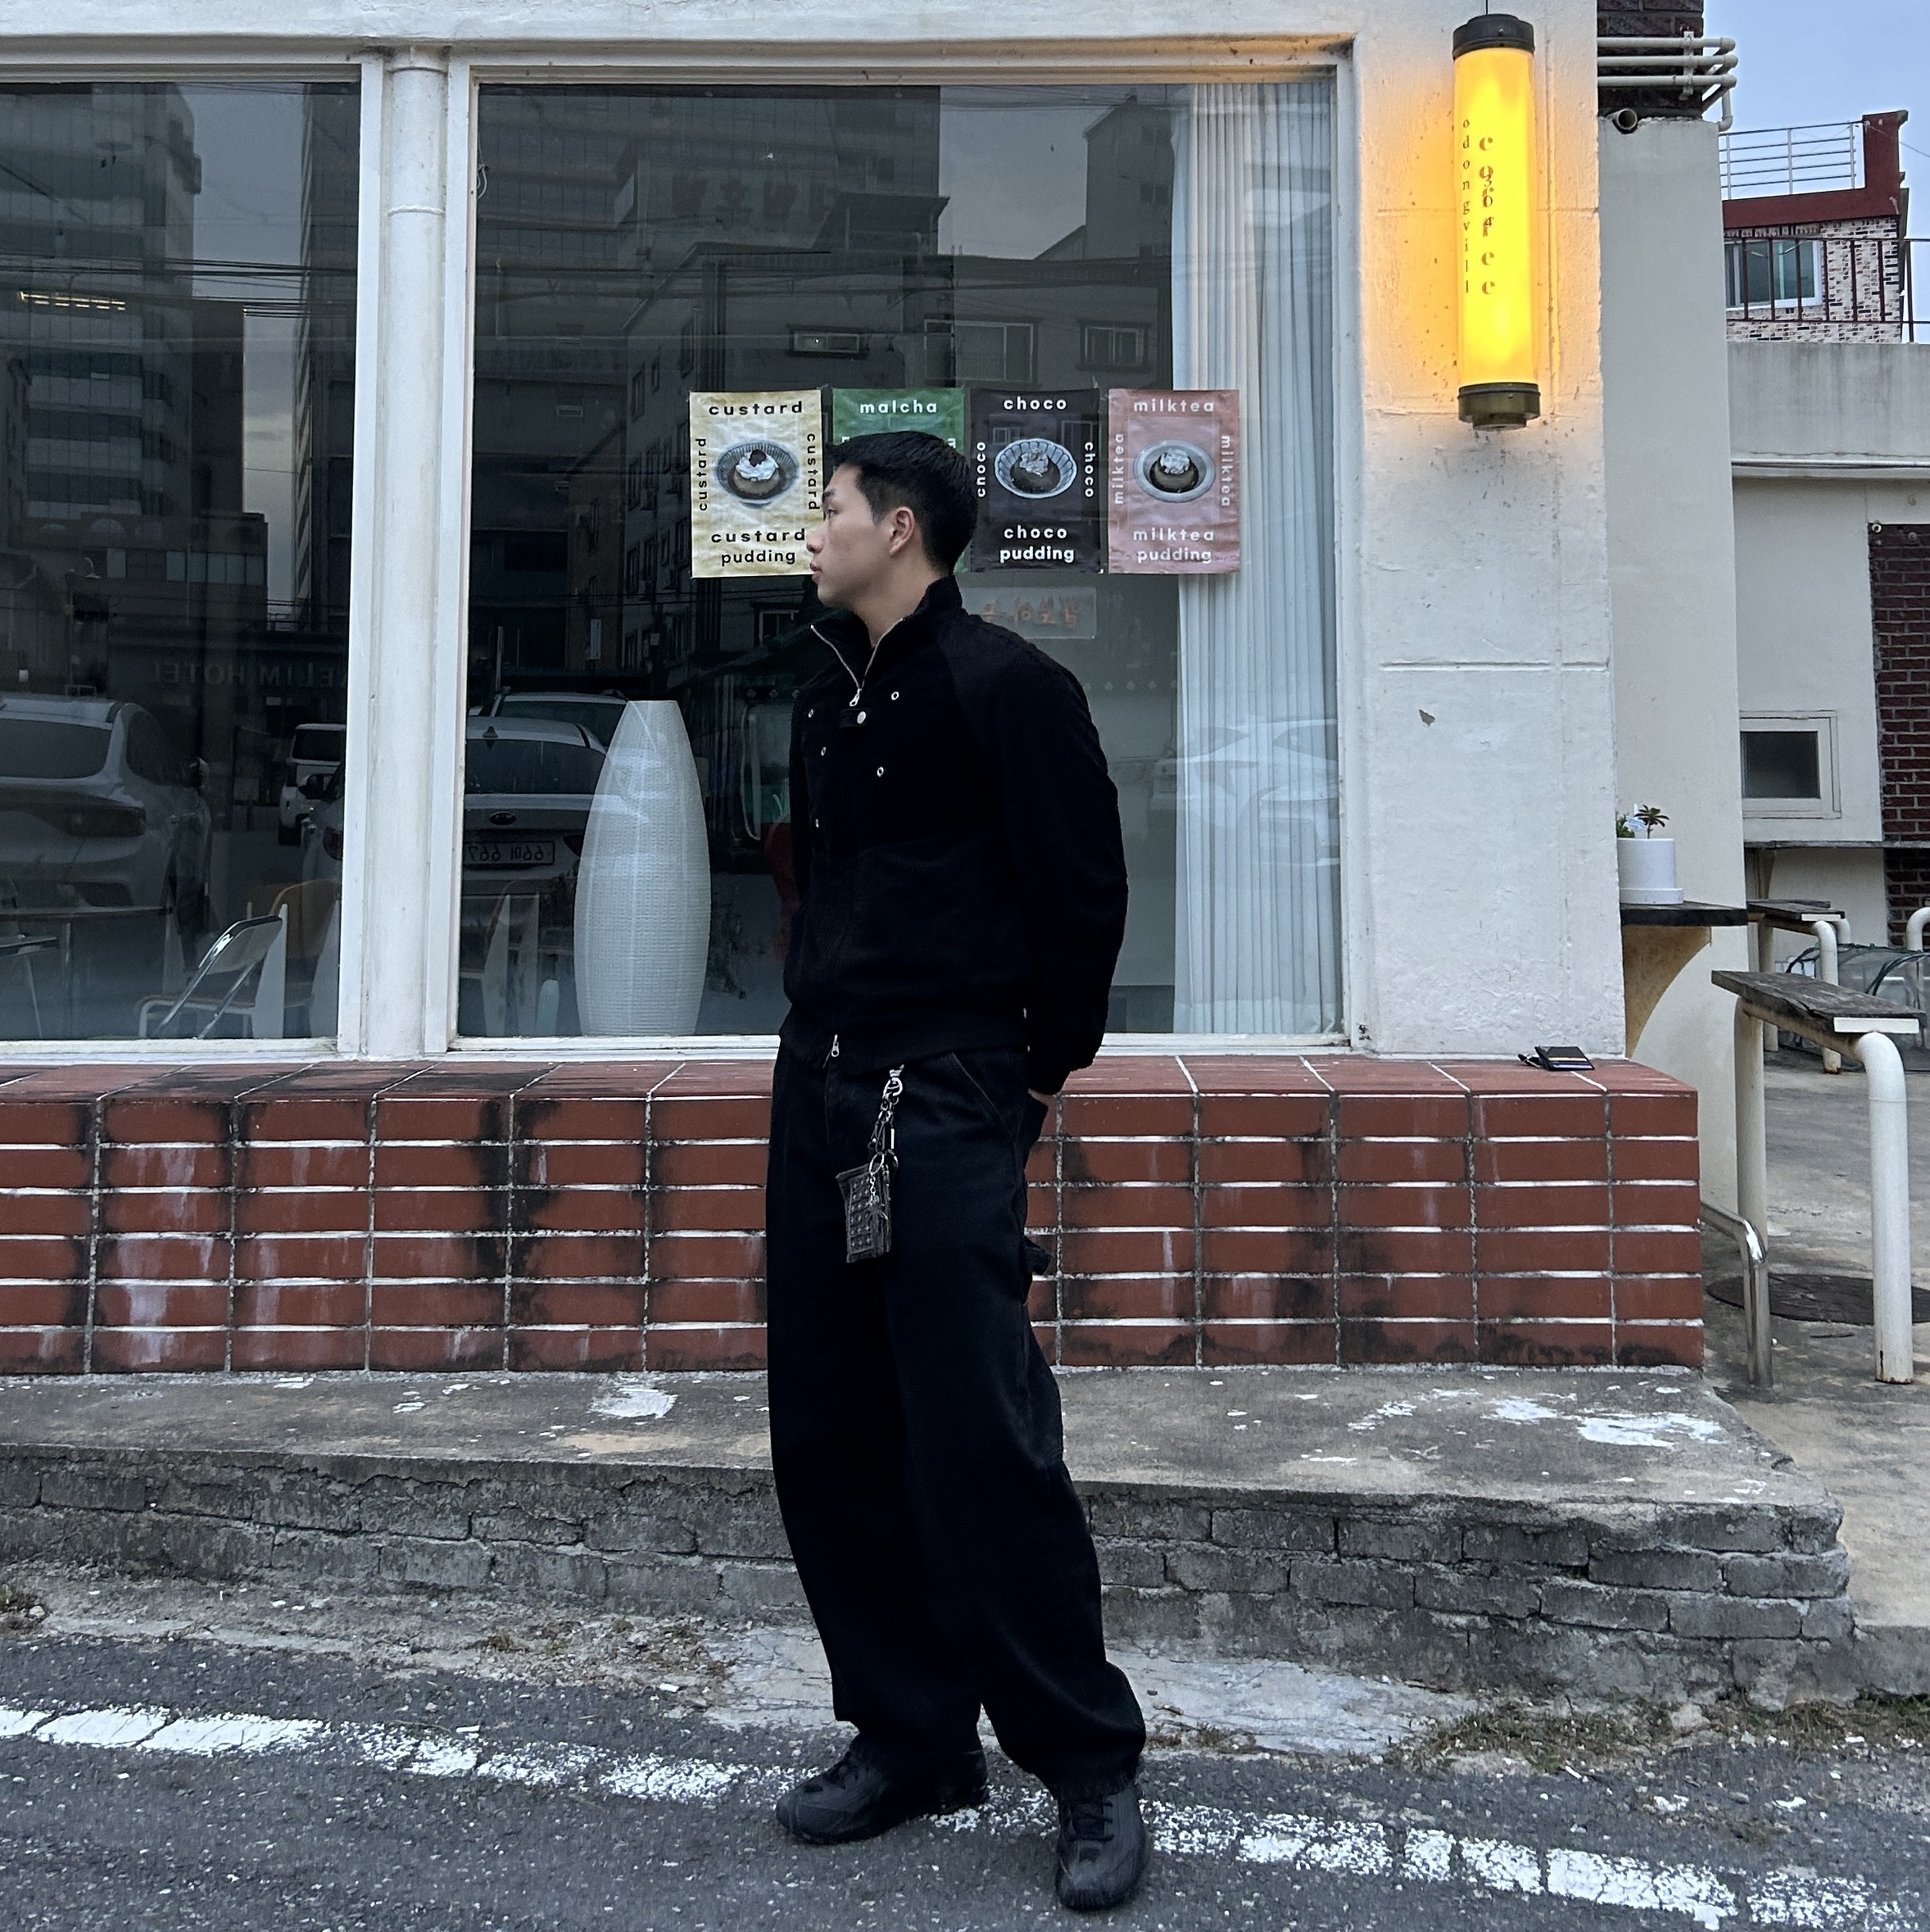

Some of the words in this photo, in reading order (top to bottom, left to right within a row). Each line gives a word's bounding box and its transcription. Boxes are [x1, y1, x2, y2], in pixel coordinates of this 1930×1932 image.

[709, 401, 803, 415] custard
[859, 399, 937, 414] malcha
[1004, 396, 1067, 410] choco
[1134, 398, 1214, 412] milktea
[695, 438, 708, 511] custard
[807, 433, 820, 510] custard
[1085, 442, 1094, 497] choco
[1112, 433, 1124, 505] milktea
[1221, 435, 1231, 506] milktea
[711, 528, 805, 543] custard
[1004, 524, 1067, 539] choco
[1133, 527, 1214, 541] milktea
[721, 549, 795, 567] pudding
[999, 545, 1075, 564] pudding
[1137, 547, 1212, 564] pudding
